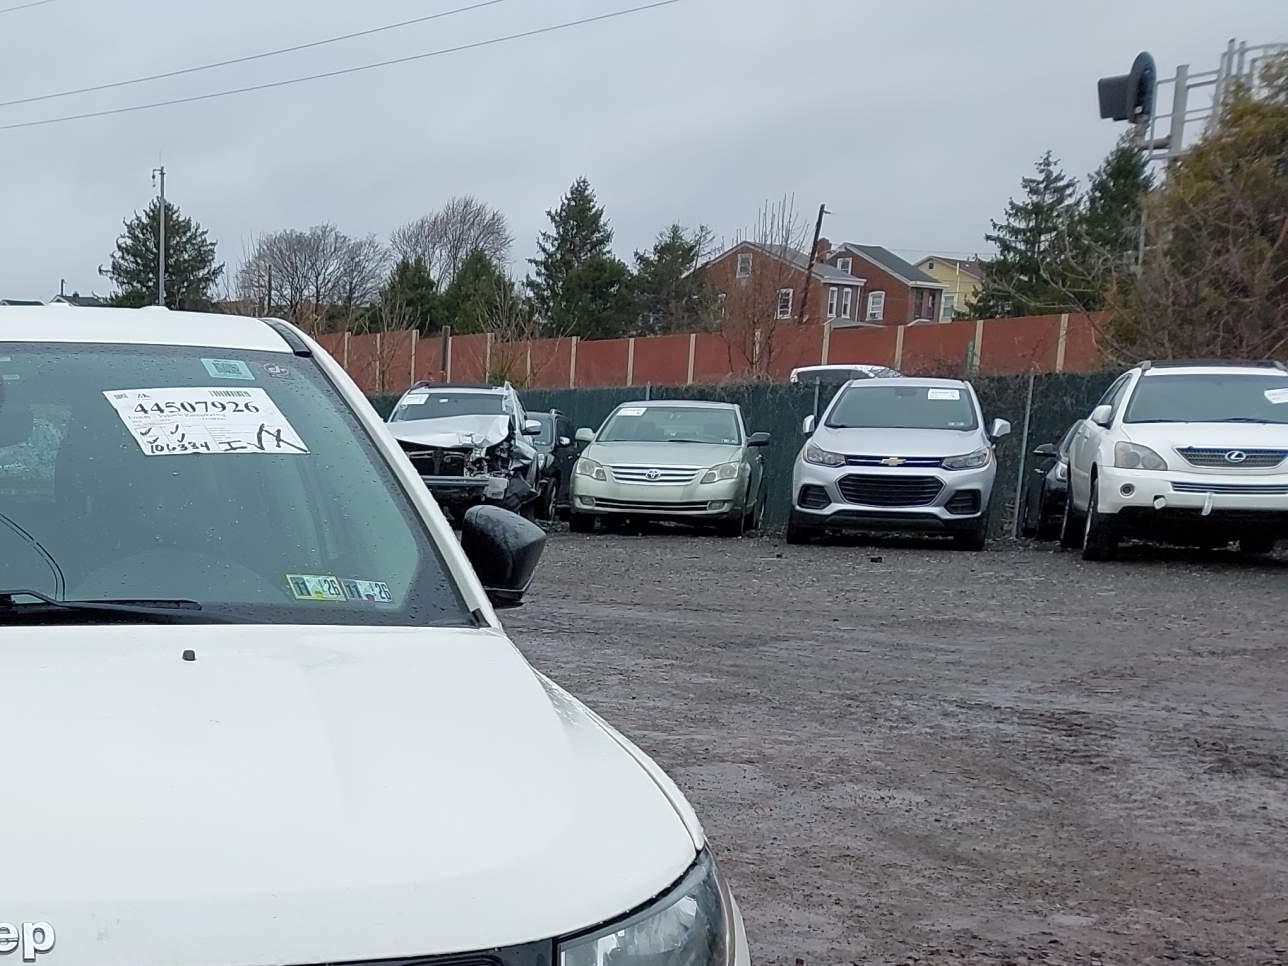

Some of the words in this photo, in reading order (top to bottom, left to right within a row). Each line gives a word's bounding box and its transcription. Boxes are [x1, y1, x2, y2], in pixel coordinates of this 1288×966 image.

[134, 401, 260, 414] 44507926
[324, 579, 341, 596] 26
[375, 582, 392, 600] 26
